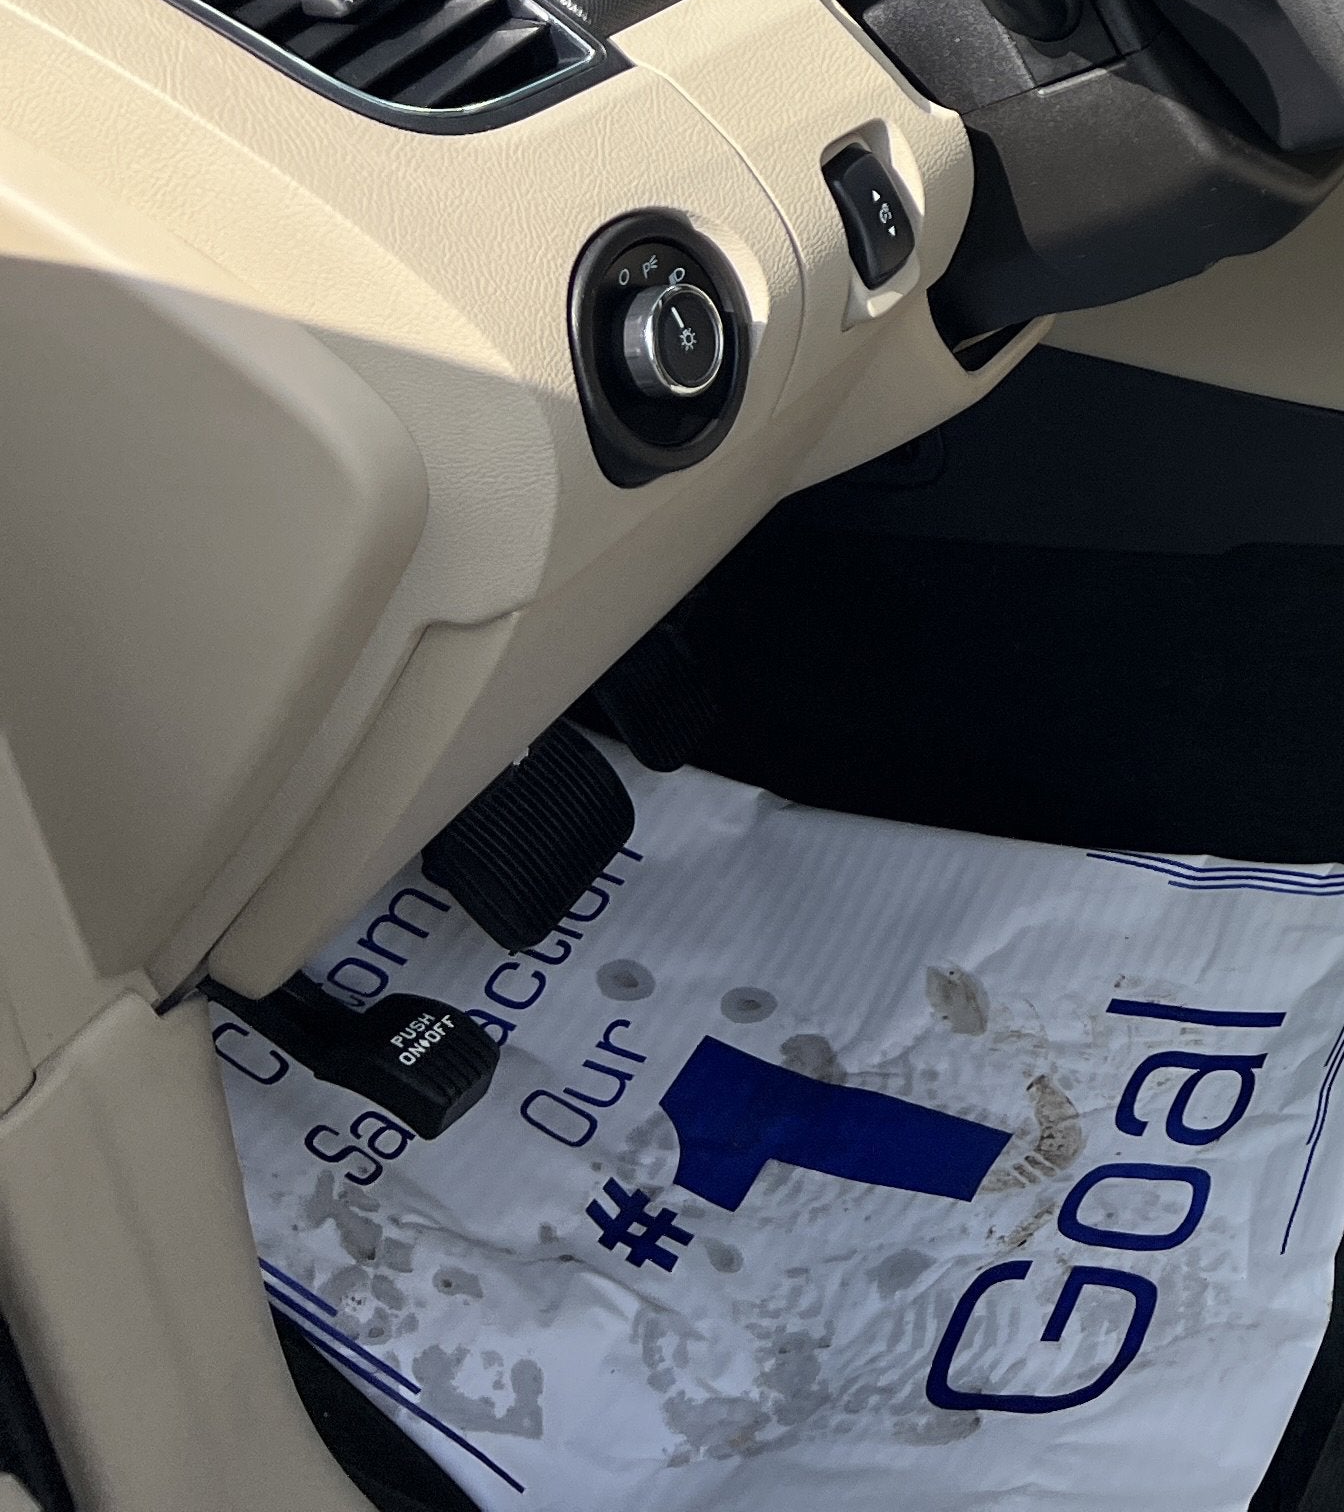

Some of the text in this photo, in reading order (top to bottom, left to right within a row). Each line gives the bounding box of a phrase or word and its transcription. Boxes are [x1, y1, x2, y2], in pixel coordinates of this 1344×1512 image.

[390, 1013, 436, 1048] PUSH
[519, 1018, 648, 1148] Our
[925, 997, 1287, 1414] Goal
